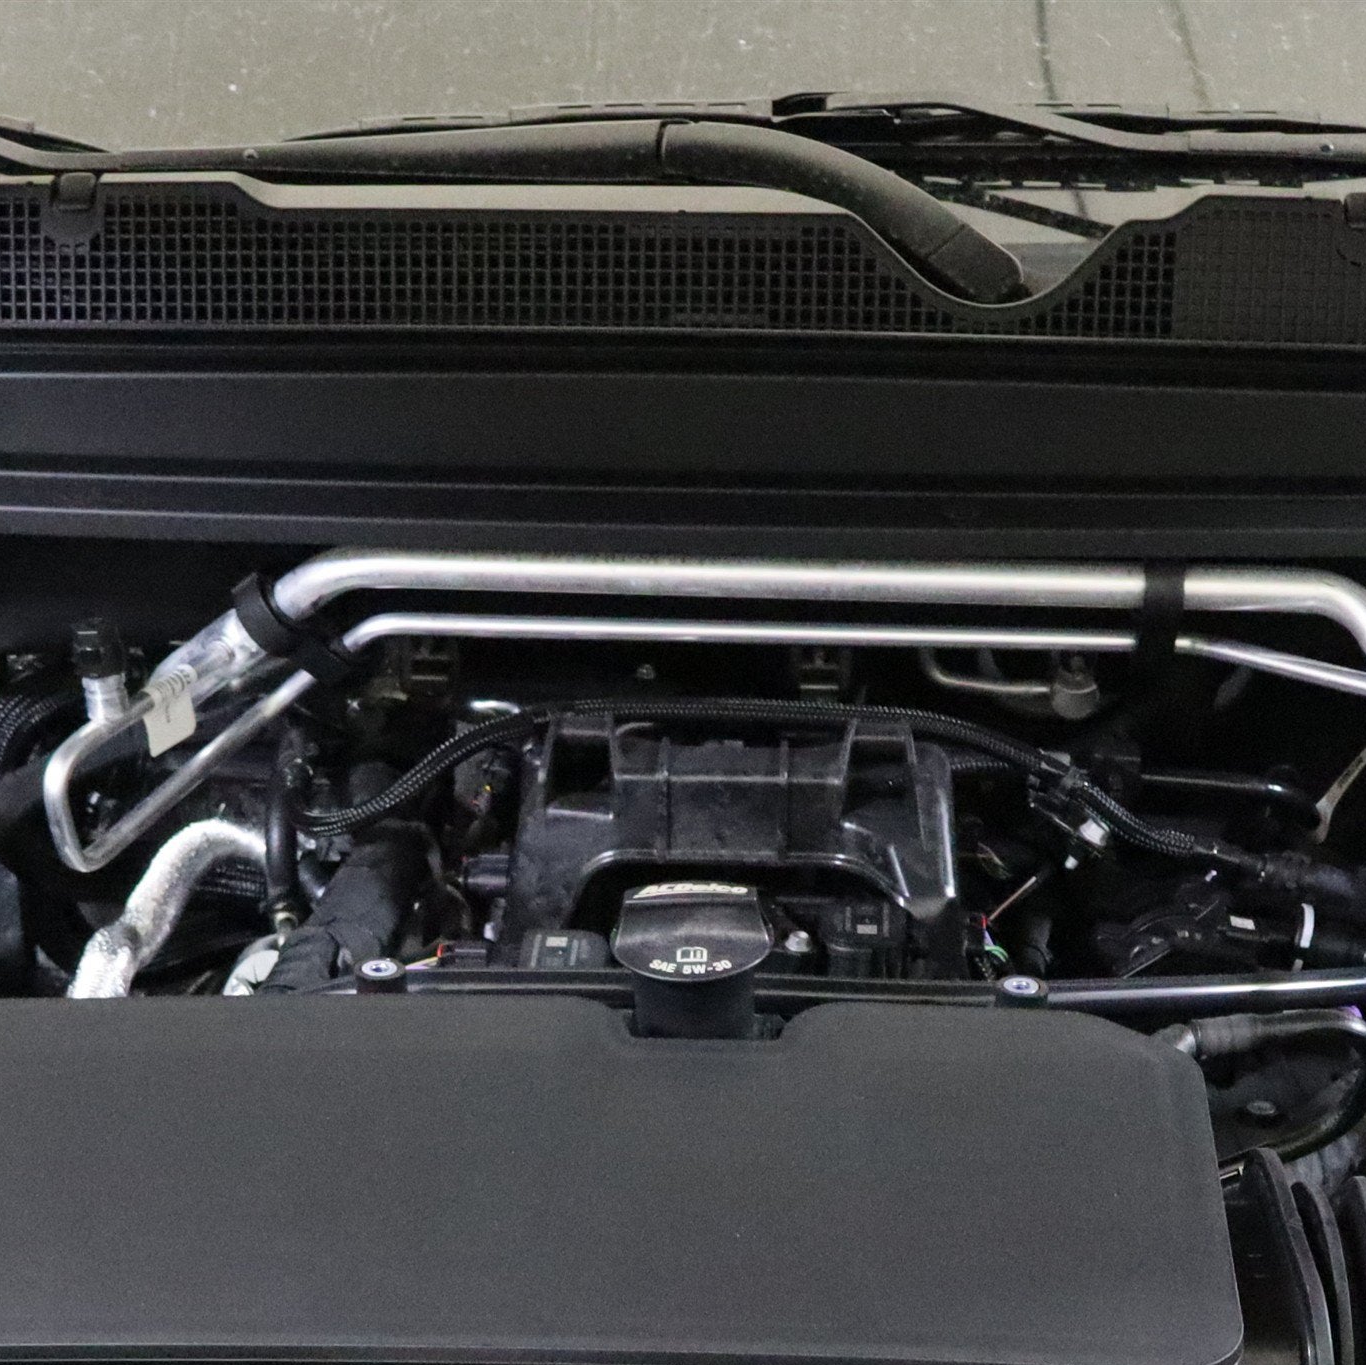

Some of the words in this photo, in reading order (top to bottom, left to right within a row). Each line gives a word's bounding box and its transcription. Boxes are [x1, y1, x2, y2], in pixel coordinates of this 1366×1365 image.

[634, 883, 749, 898] ACDelco
[649, 959, 677, 973] SAE
[682, 959, 733, 975] 5W-30
